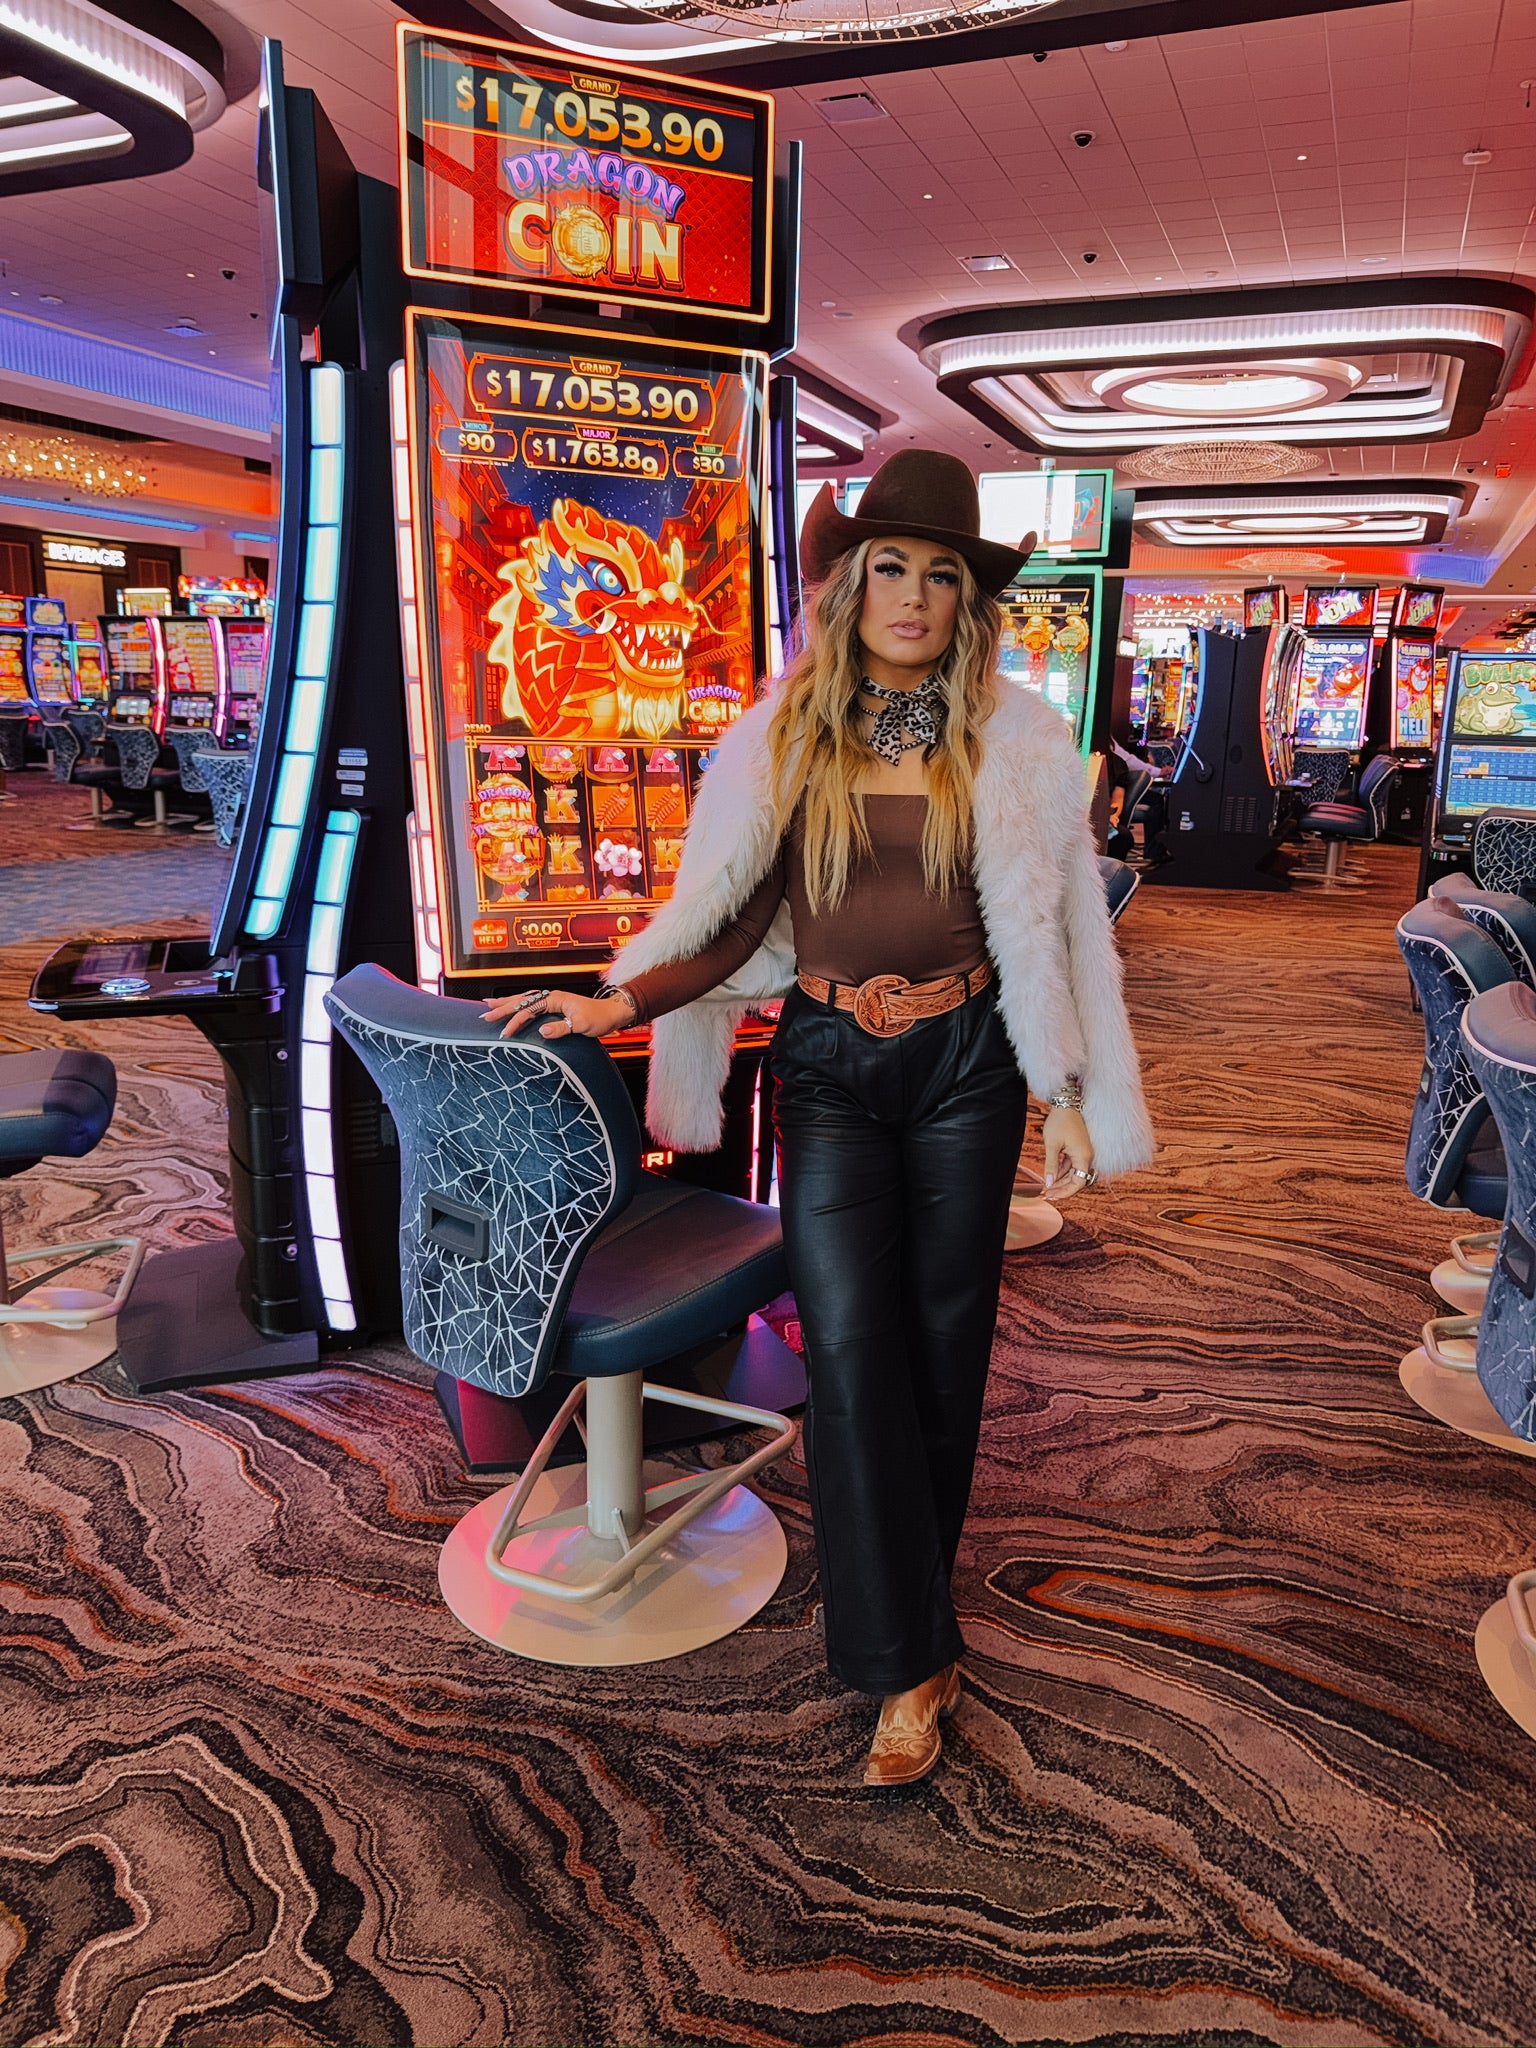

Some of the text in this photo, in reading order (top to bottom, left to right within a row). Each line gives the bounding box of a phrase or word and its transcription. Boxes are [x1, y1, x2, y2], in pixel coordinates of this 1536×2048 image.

[579, 78, 612, 93] GRAND
[455, 75, 724, 161] $17,053.90
[503, 150, 686, 217] DRAGON
[507, 200, 684, 290] COIN
[579, 361, 613, 375] GRAND
[486, 369, 699, 423] $17,053.90
[464, 421, 488, 431] MINOR
[582, 428, 611, 440] MAJOR
[458, 433, 495, 453] $90
[693, 456, 726, 475] $30
[687, 684, 742, 702] DRAGON
[688, 701, 742, 721] COIN
[463, 723, 492, 734] DEMO
[477, 785, 532, 801] DRAGON
[479, 801, 533, 821] COIN
[521, 916, 632, 937] $0.00 0
[478, 935, 504, 945] HELP
